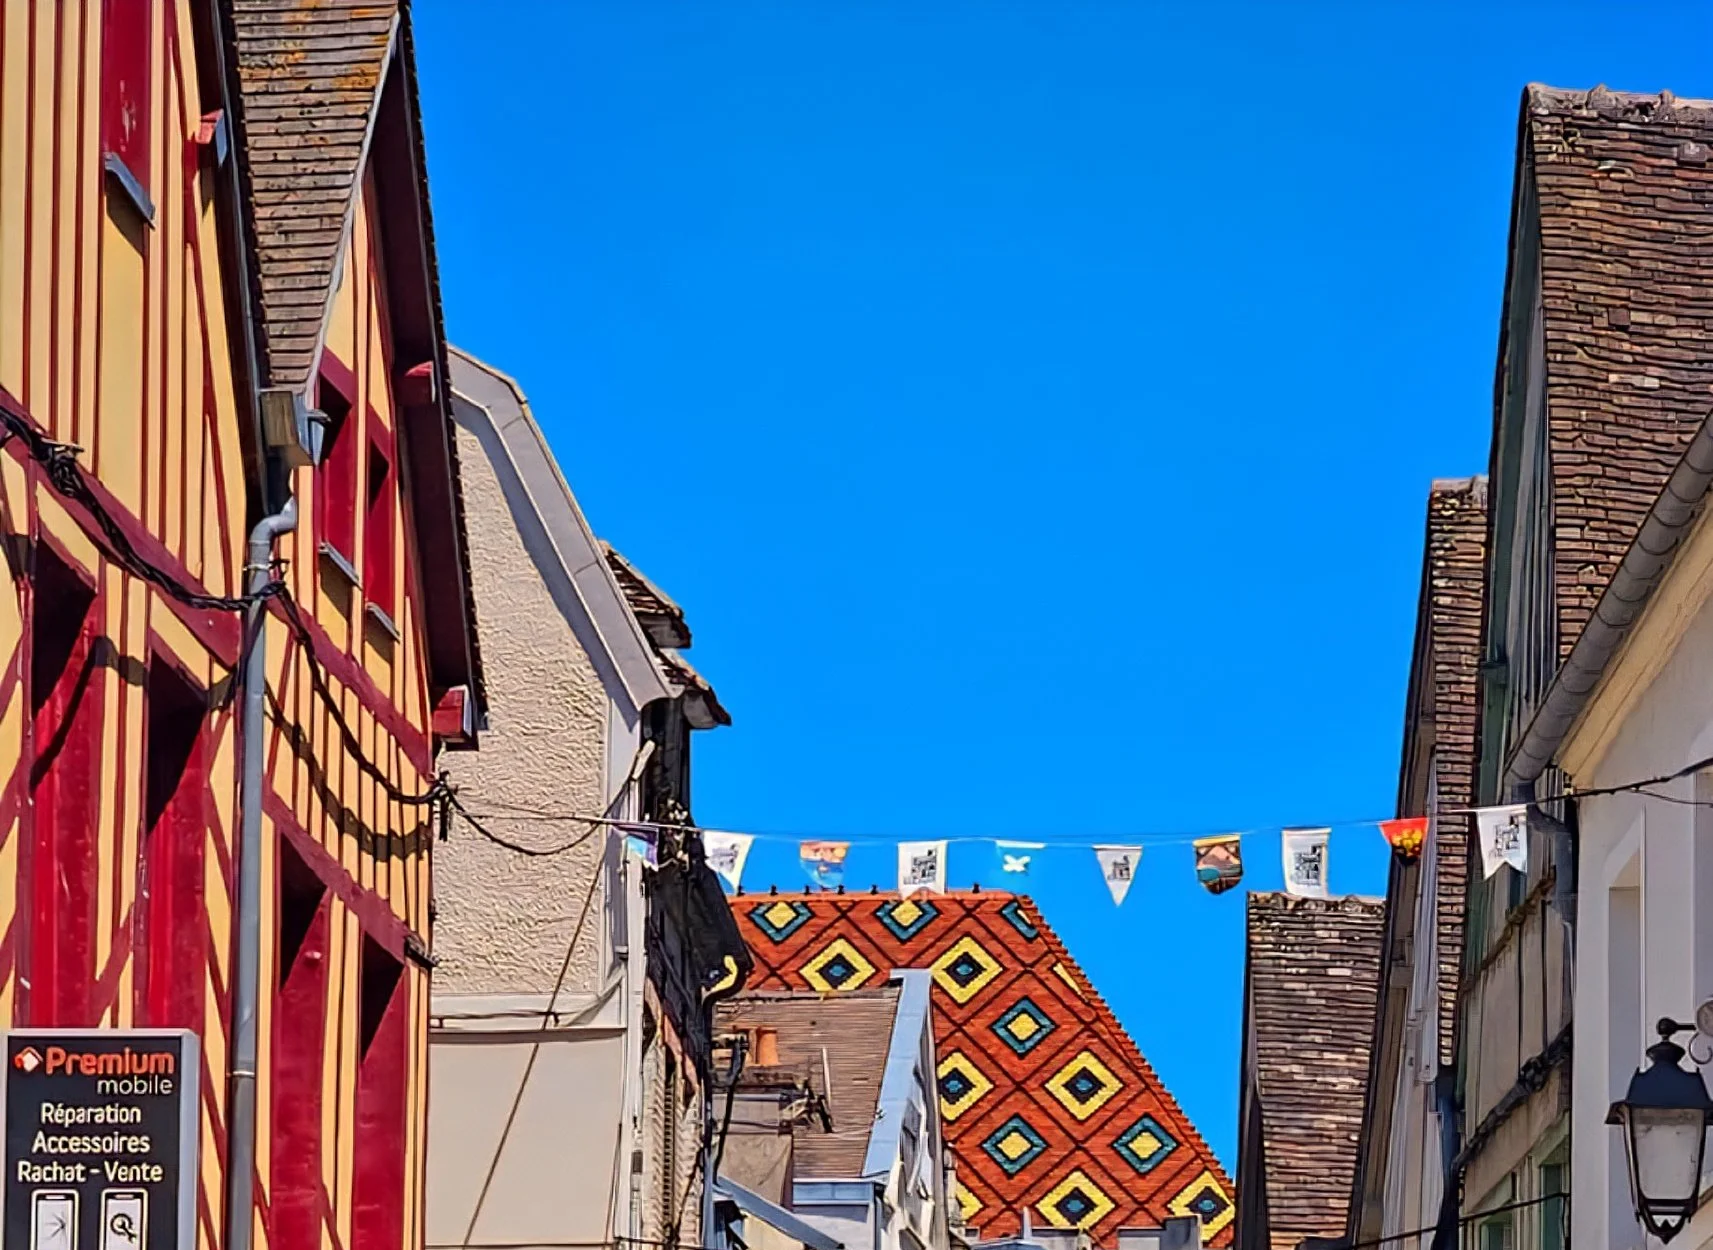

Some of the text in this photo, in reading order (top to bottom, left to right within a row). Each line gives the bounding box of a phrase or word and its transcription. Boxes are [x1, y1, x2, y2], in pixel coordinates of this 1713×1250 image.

[46, 1047, 174, 1076] Premium
[97, 1075, 173, 1095] mobile
[41, 1103, 141, 1127] Réparation
[32, 1131, 150, 1154] Accessoires
[18, 1162, 86, 1182] Rachat
[104, 1162, 163, 1182] Vente
